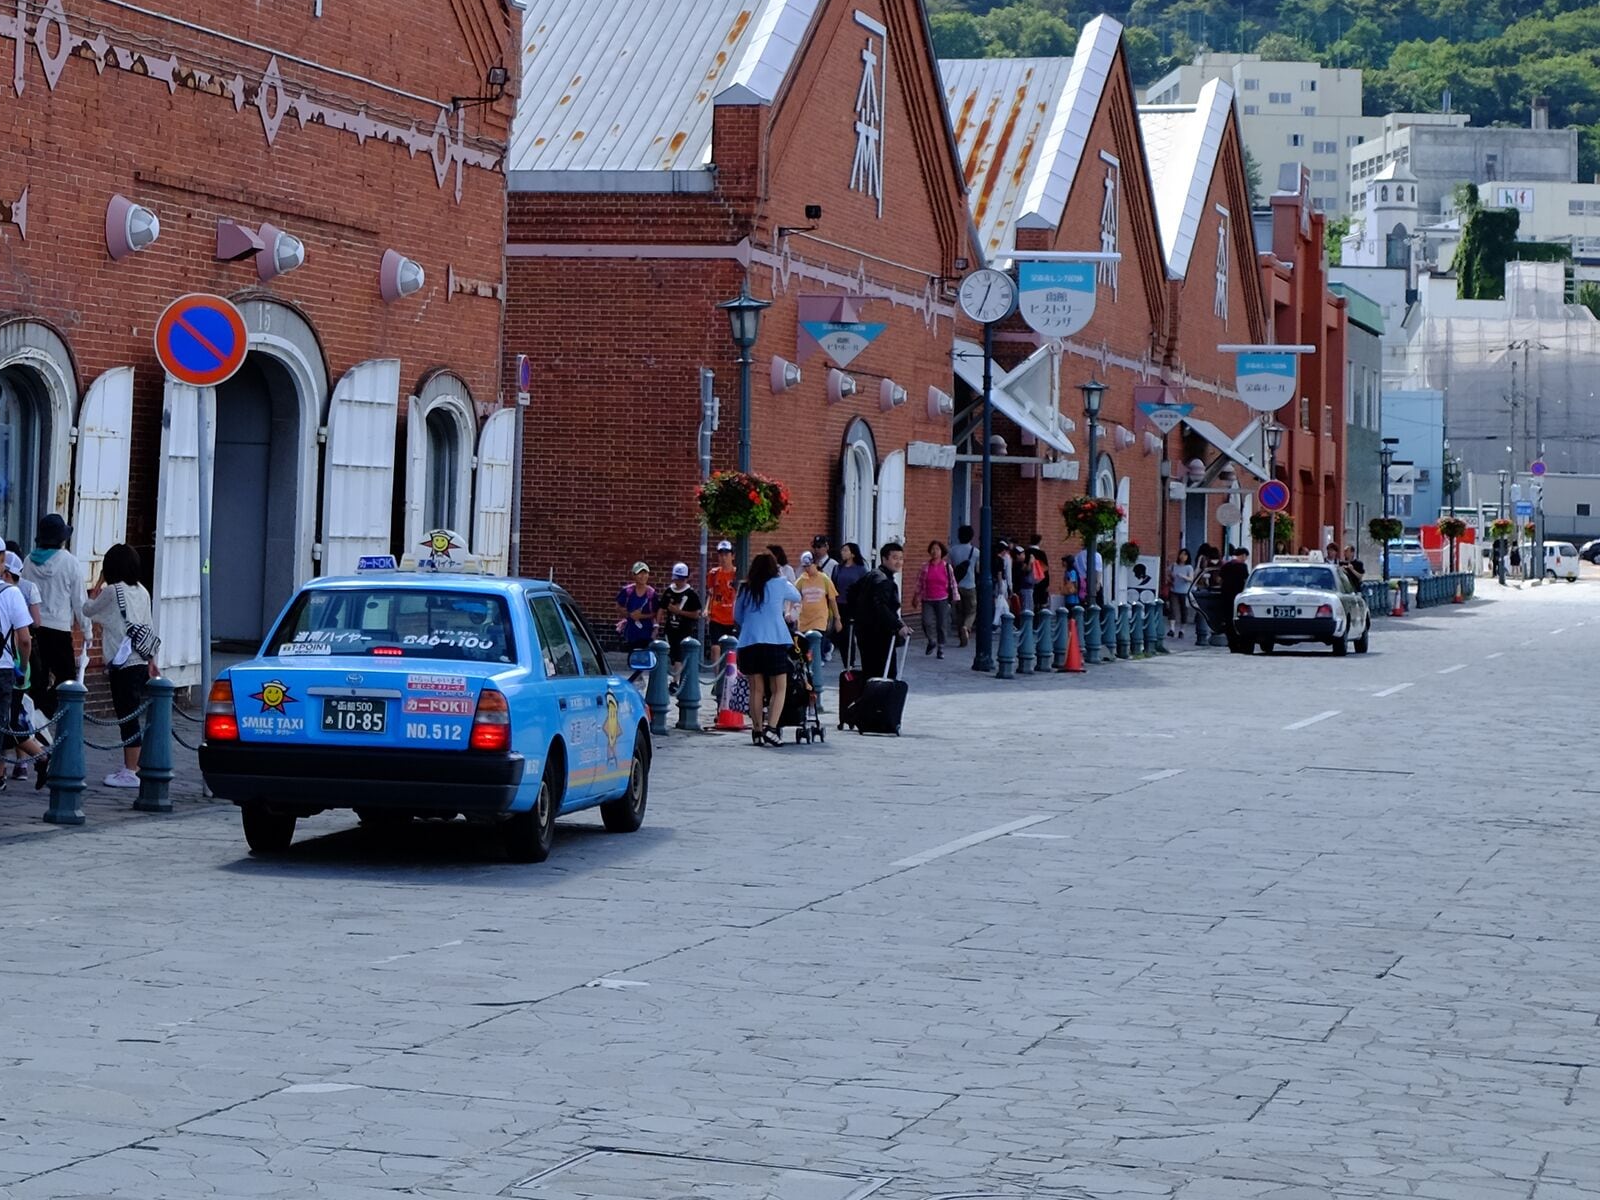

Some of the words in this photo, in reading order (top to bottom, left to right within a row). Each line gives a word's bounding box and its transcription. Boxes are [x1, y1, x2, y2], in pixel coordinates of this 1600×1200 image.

[358, 557, 393, 569] カードOK
[407, 699, 468, 713] カードOK!!
[241, 716, 274, 729] SMILE
[276, 717, 304, 730] TAXI
[337, 711, 383, 731] 10-85
[406, 722, 462, 740] NO.512
